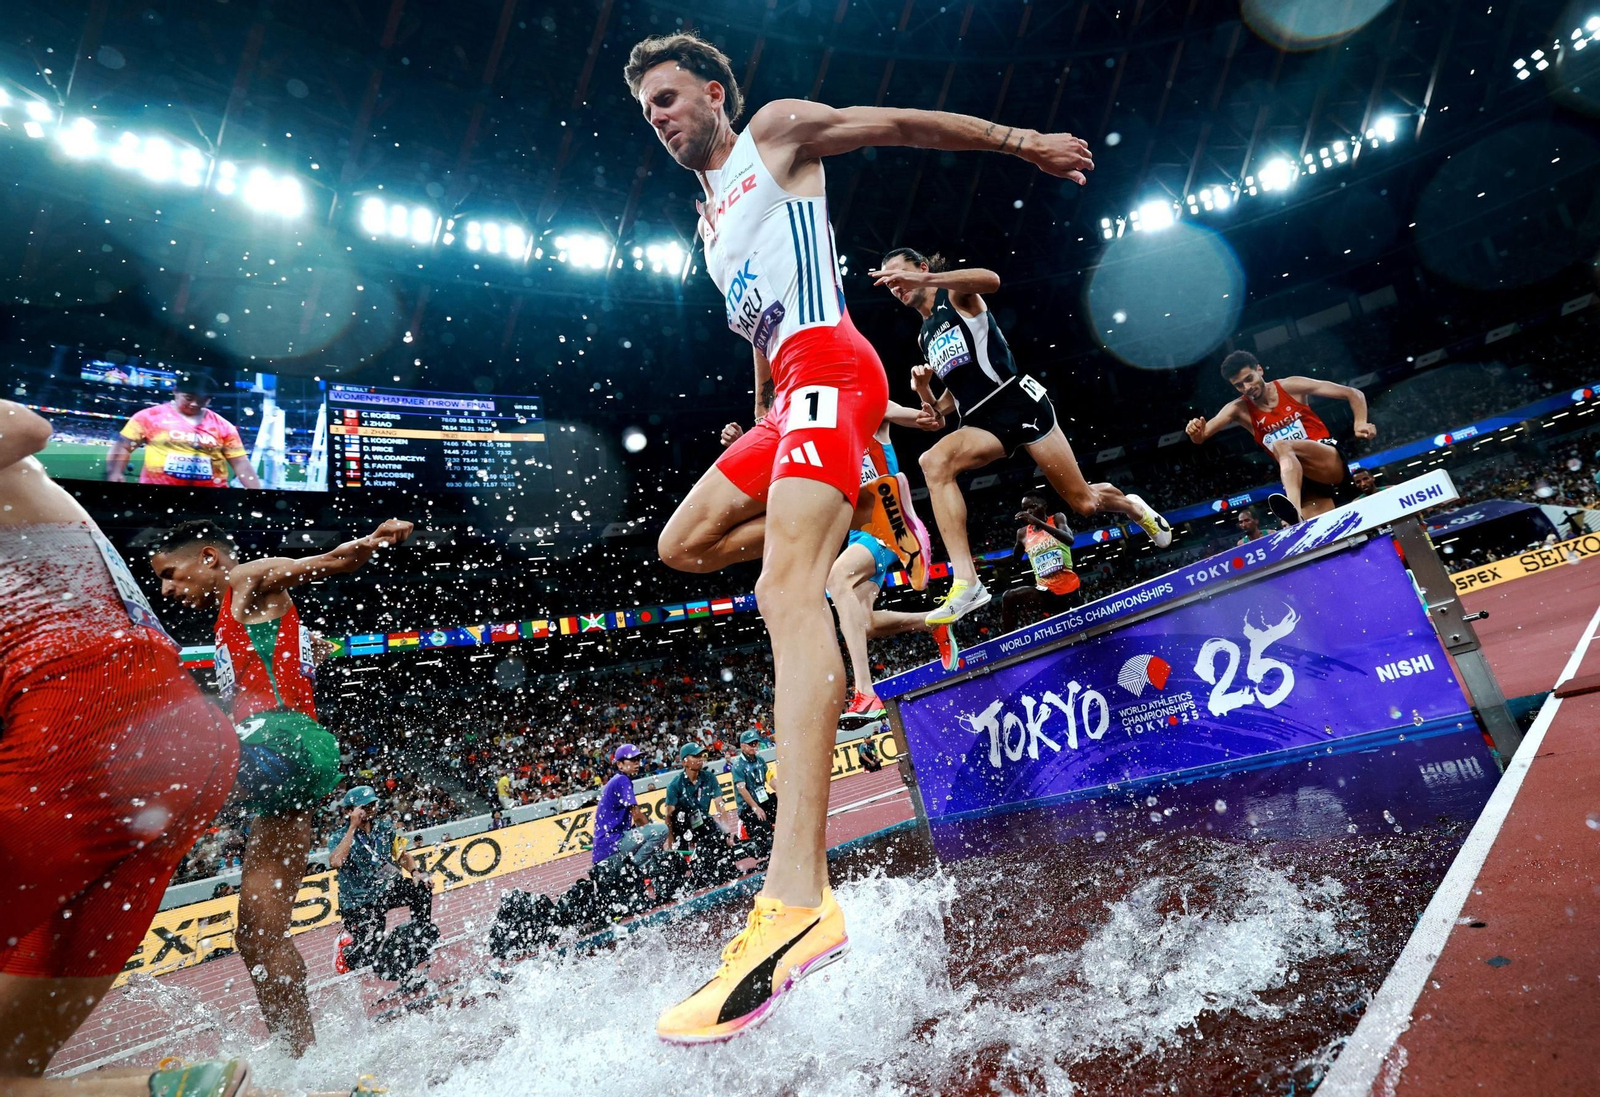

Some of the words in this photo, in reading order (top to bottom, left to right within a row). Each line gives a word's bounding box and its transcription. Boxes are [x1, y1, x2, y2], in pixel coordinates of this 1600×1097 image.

[727, 259, 758, 312] TDK
[737, 288, 763, 341] ARU
[931, 329, 959, 355] TDK
[333, 391, 380, 403] WOMEN'S
[382, 395, 425, 407] HAMMER
[427, 398, 460, 408] THROW
[804, 390, 819, 422] 1
[370, 412, 401, 420] ROGERS
[370, 420, 392, 428] ZHAO
[169, 429, 217, 446] CHINA
[370, 437, 409, 445] KOSONEN
[1270, 421, 1300, 440] TDK
[168, 462, 210, 474] ZHANG
[859, 468, 877, 485] EAN
[1398, 483, 1444, 509] NISHI
[1030, 536, 1058, 555] KENYA
[1041, 550, 1059, 560] TDK
[1451, 566, 1502, 592] SPEX
[1519, 535, 1600, 573] SEIKO
[999, 633, 1032, 653] WORLD
[1033, 613, 1084, 641] ATHLETICS
[1085, 582, 1174, 623] CHAMPIONSHIPS
[1244, 548, 1267, 566] 25
[1194, 601, 1301, 717] 25
[1375, 653, 1435, 682] NISHI
[1118, 703, 1148, 718] WORLD
[1148, 691, 1193, 710] ATHLETICS
[1121, 700, 1196, 727] CHAMPIONSHIPS
[1180, 710, 1200, 723] 25
[954, 680, 1110, 768] TOKYO
